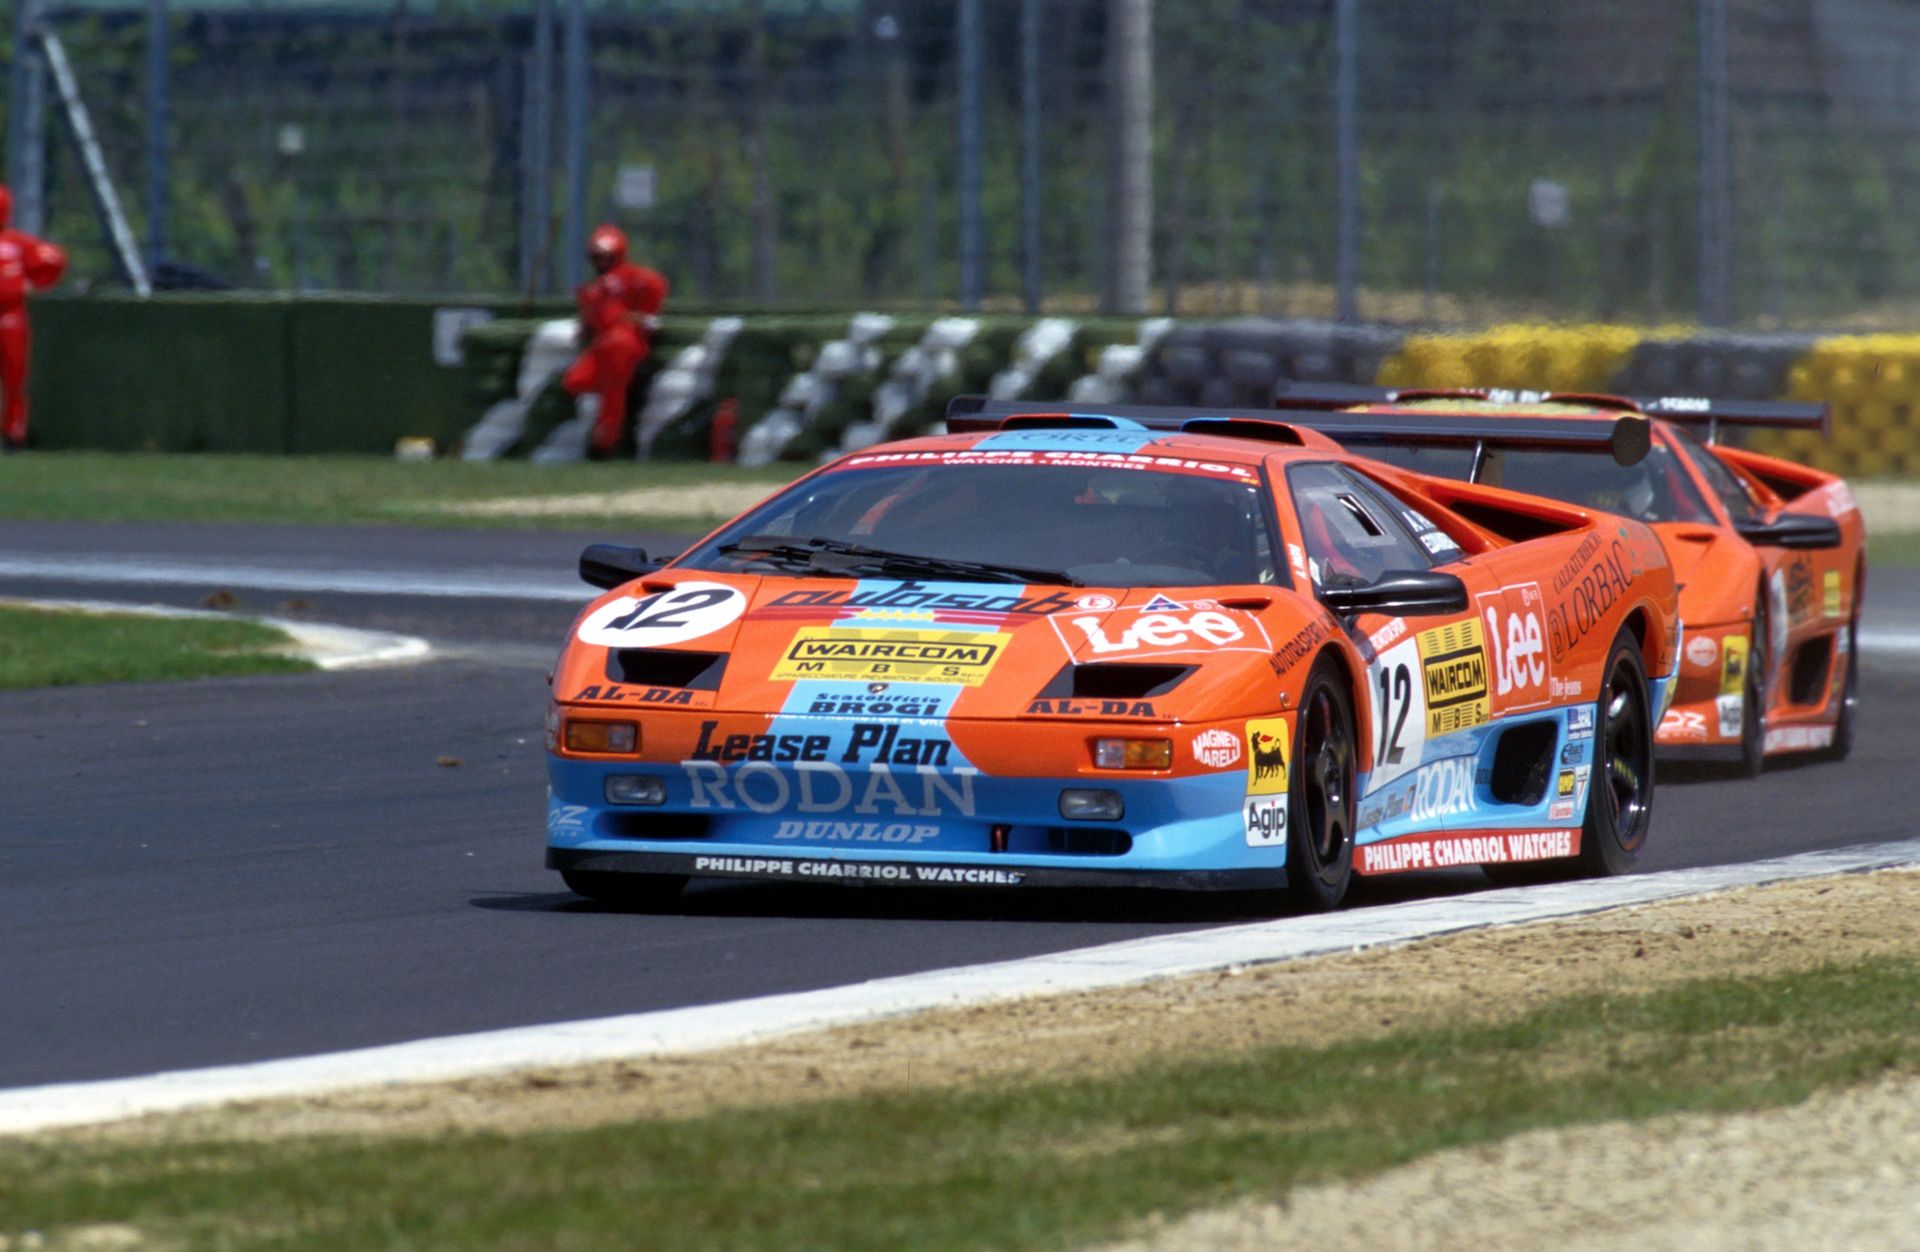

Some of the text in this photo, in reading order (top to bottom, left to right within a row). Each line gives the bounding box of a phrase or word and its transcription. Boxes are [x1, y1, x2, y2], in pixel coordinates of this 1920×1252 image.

[848, 450, 1252, 478] PHILIPPE CHARRIOL
[943, 457, 1146, 470] WATCHES MONTRES
[602, 589, 735, 631] 12
[1559, 539, 1634, 651] LORBAC
[1071, 611, 1245, 653] Lee
[805, 643, 981, 661] WAIRCOM
[1486, 605, 1548, 697] Lee
[796, 662, 826, 672] M
[869, 663, 892, 674] B
[941, 666, 961, 677] S
[1426, 657, 1484, 698] WAIRCOM
[572, 685, 695, 705] AL-DA
[807, 701, 940, 717] BROGI
[815, 692, 943, 704] Scatolificio
[1025, 699, 1157, 718] AL-DA
[1377, 662, 1413, 768] 12
[1431, 702, 1483, 733] M B S
[691, 720, 951, 767] Lease Plan
[679, 759, 980, 818] RODAN
[1410, 755, 1479, 823] RODAN
[773, 819, 941, 844] DUNLOP
[1248, 800, 1287, 839] Agip
[1364, 831, 1572, 872] PHILIPPE CHARRIOL WATCHES
[695, 856, 1022, 885] PHILIPPE CHARRIOL WATCHES
